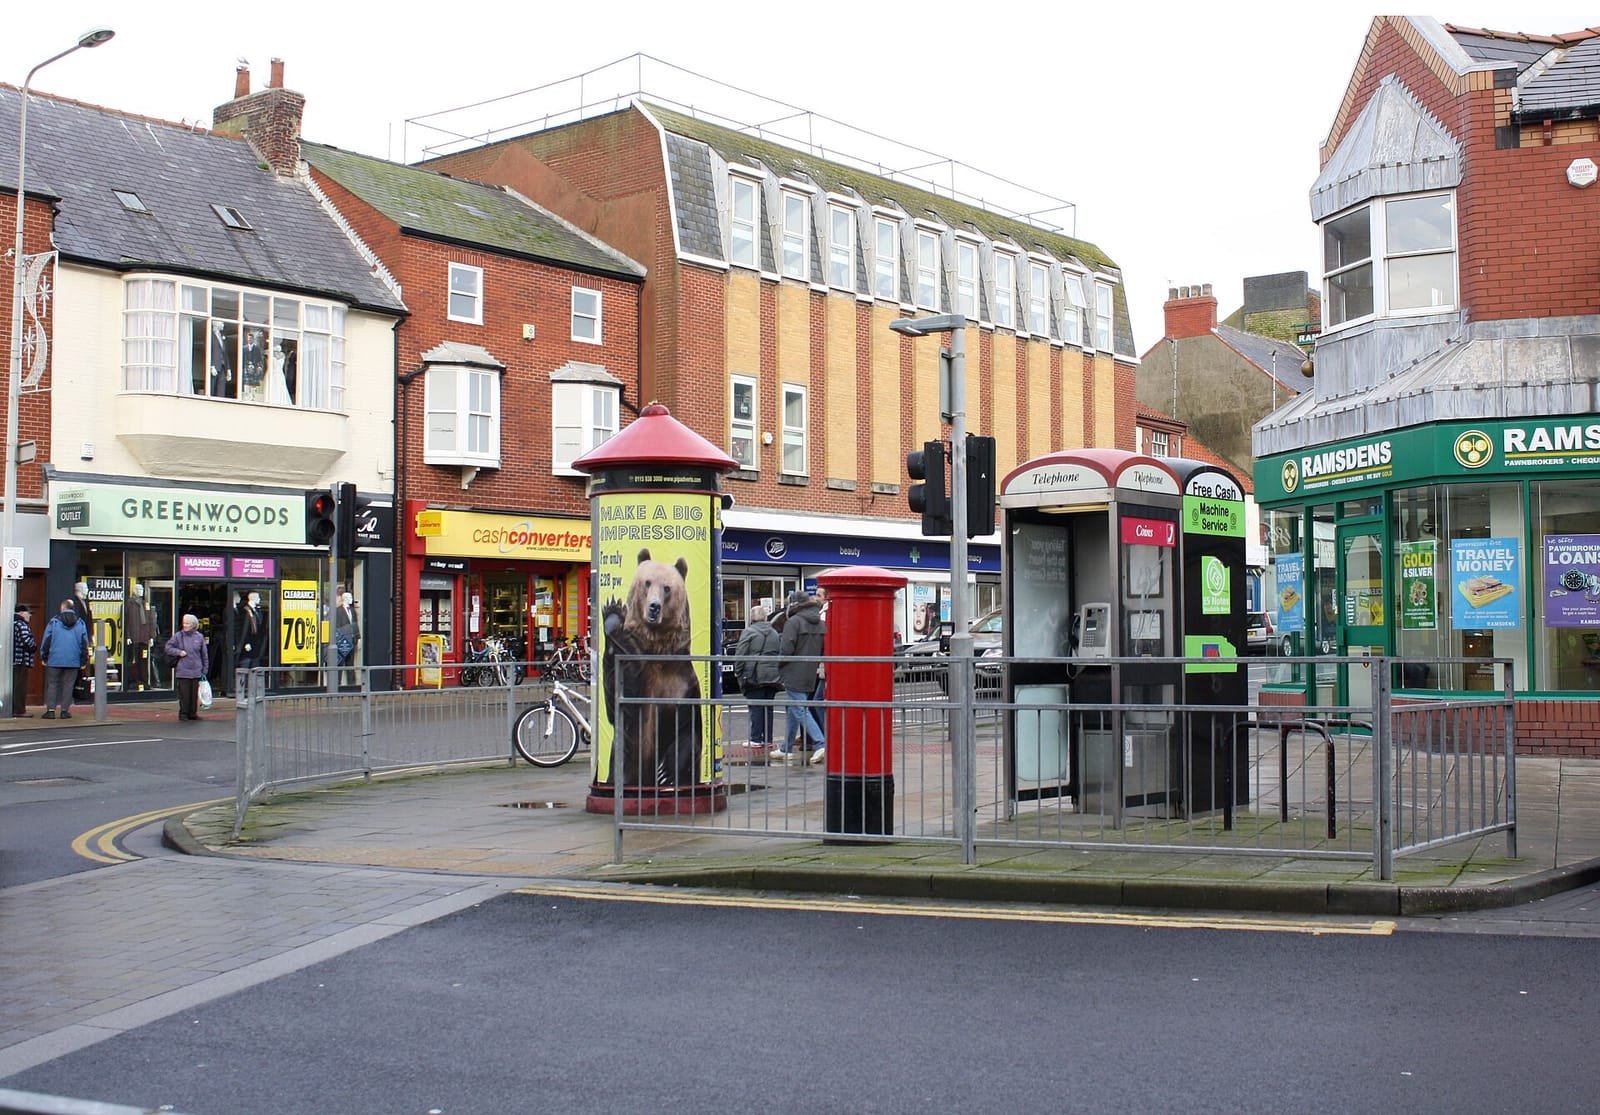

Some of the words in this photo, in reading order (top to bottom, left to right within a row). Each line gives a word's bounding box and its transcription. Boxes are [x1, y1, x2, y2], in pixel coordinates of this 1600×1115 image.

[1504, 425, 1600, 452] RAMS
[1302, 441, 1392, 477] RAMSDENS
[1033, 472, 1080, 485] Telephone
[1134, 471, 1163, 485] Telephone
[1192, 481, 1212, 498] Free
[1215, 484, 1236, 500] Cash
[60, 511, 82, 521] OUTLET
[121, 498, 289, 526] GREENWOODS
[600, 505, 647, 522] MAKE
[652, 505, 667, 520] A
[672, 505, 703, 521] BIG
[1200, 502, 1229, 517] Machine
[176, 523, 239, 534] MENSWEAR
[1135, 525, 1154, 538] Coins
[1201, 519, 1228, 532] Service
[600, 525, 707, 542] IMPRESSION
[839, 546, 861, 557] beauty
[1456, 549, 1514, 560] TRAVEL
[184, 558, 221, 567] MANSIZE
[1403, 553, 1433, 568] GOLD
[1548, 552, 1600, 565] LOAN
[1277, 562, 1300, 572] TRAVEL
[1456, 560, 1513, 572] MONEY
[1277, 572, 1300, 583] MONEY
[95, 580, 122, 589] FINAL
[913, 585, 928, 596] new
[284, 591, 315, 599] CLEARANCE
